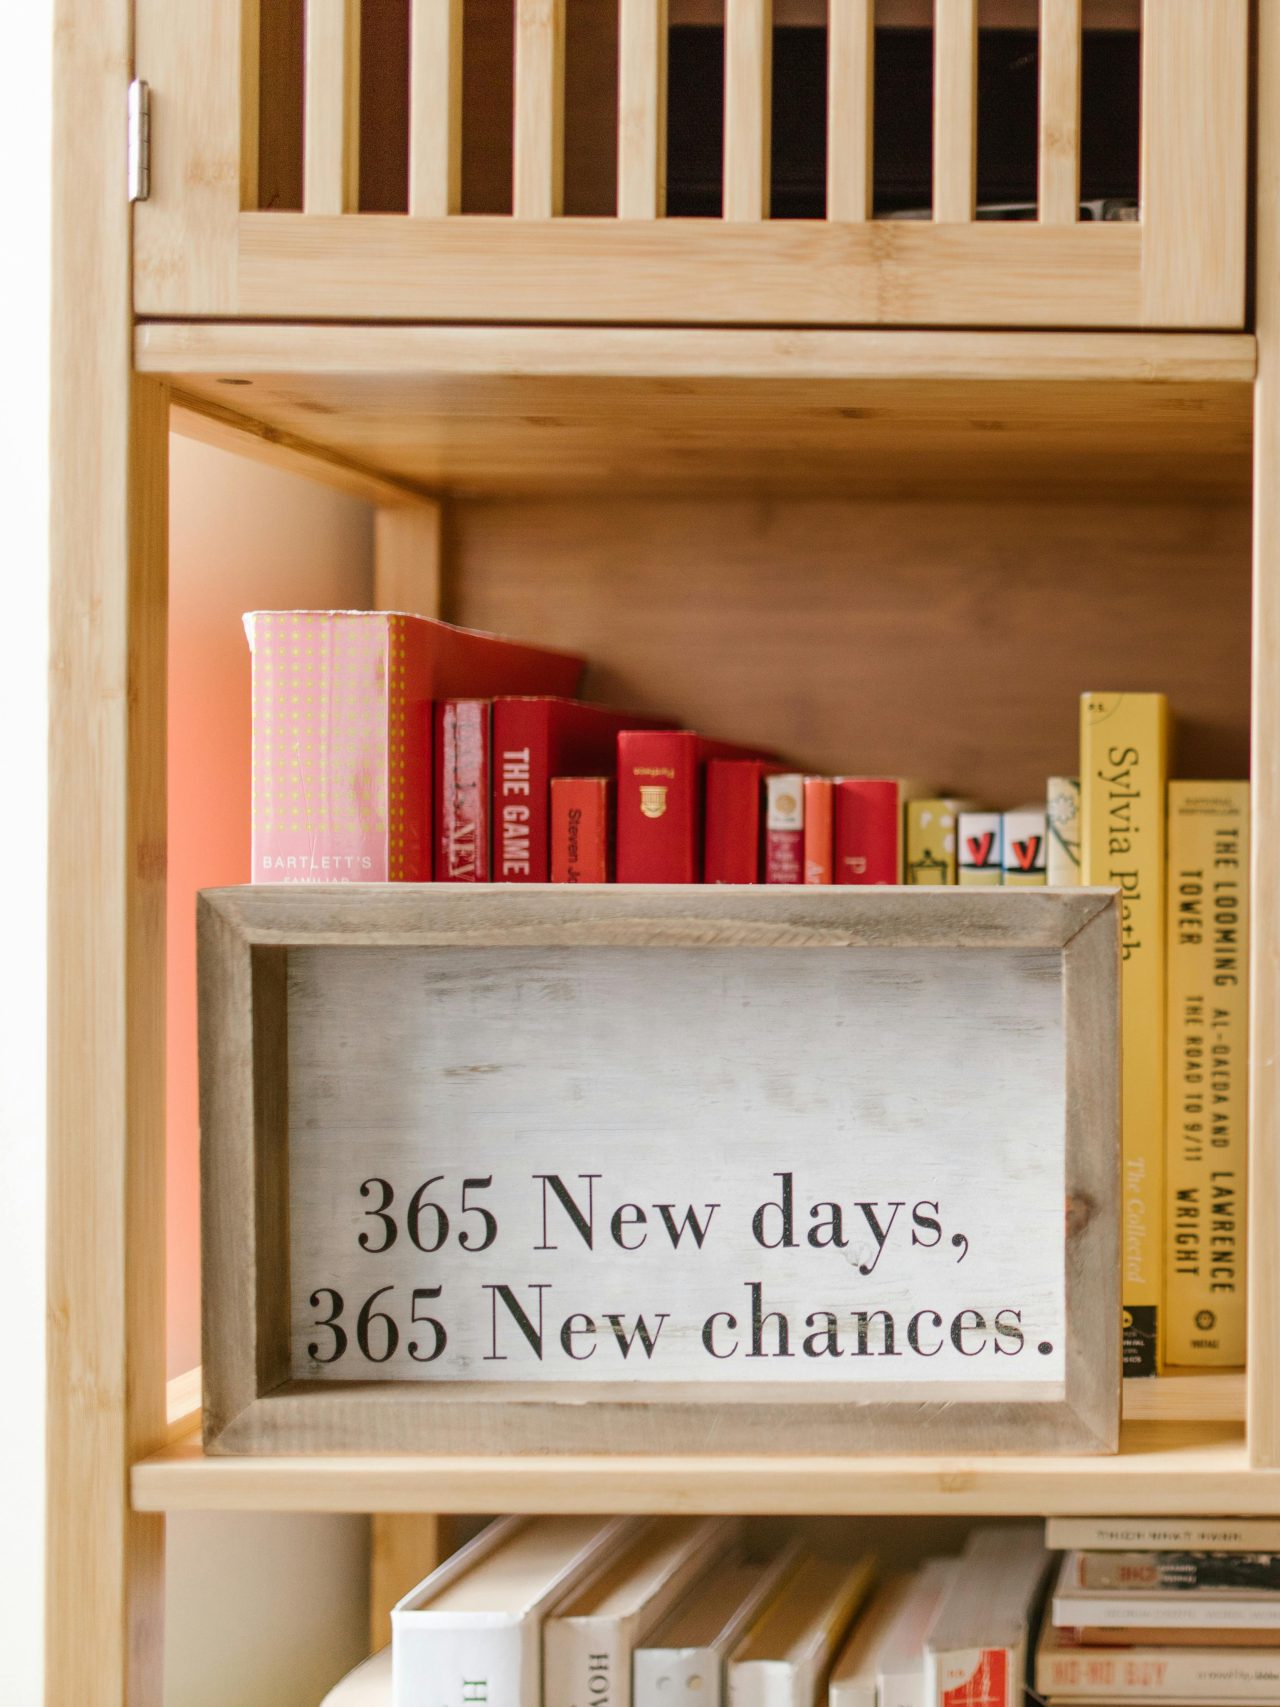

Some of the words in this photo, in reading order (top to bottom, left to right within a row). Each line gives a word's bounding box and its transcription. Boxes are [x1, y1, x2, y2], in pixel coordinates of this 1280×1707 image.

[502, 747, 531, 797] THE
[1098, 746, 1141, 856] Sylvia
[262, 855, 373, 870] BARTLETT'S
[502, 805, 531, 876] GAME
[567, 808, 582, 863] Steven
[1214, 828, 1240, 868] THE
[1179, 870, 1204, 945] TOWER
[1213, 882, 1240, 987] LOOMING
[1184, 996, 1204, 1027] THE
[1184, 1036, 1204, 1084] ROAD
[1210, 1008, 1231, 1104] AL-QAEDA
[1183, 1094, 1203, 1114] TO
[1209, 1113, 1230, 1149] AND
[1183, 1122, 1203, 1161] 9/11
[357, 1174, 498, 1254] 365
[532, 1173, 722, 1252] New
[751, 1171, 970, 1276] days,
[1174, 1188, 1201, 1276] WRIGHT
[1209, 1171, 1236, 1293] LAWRENCE
[307, 1284, 448, 1363] 365
[481, 1283, 671, 1361] New
[701, 1281, 1054, 1359] chances.
